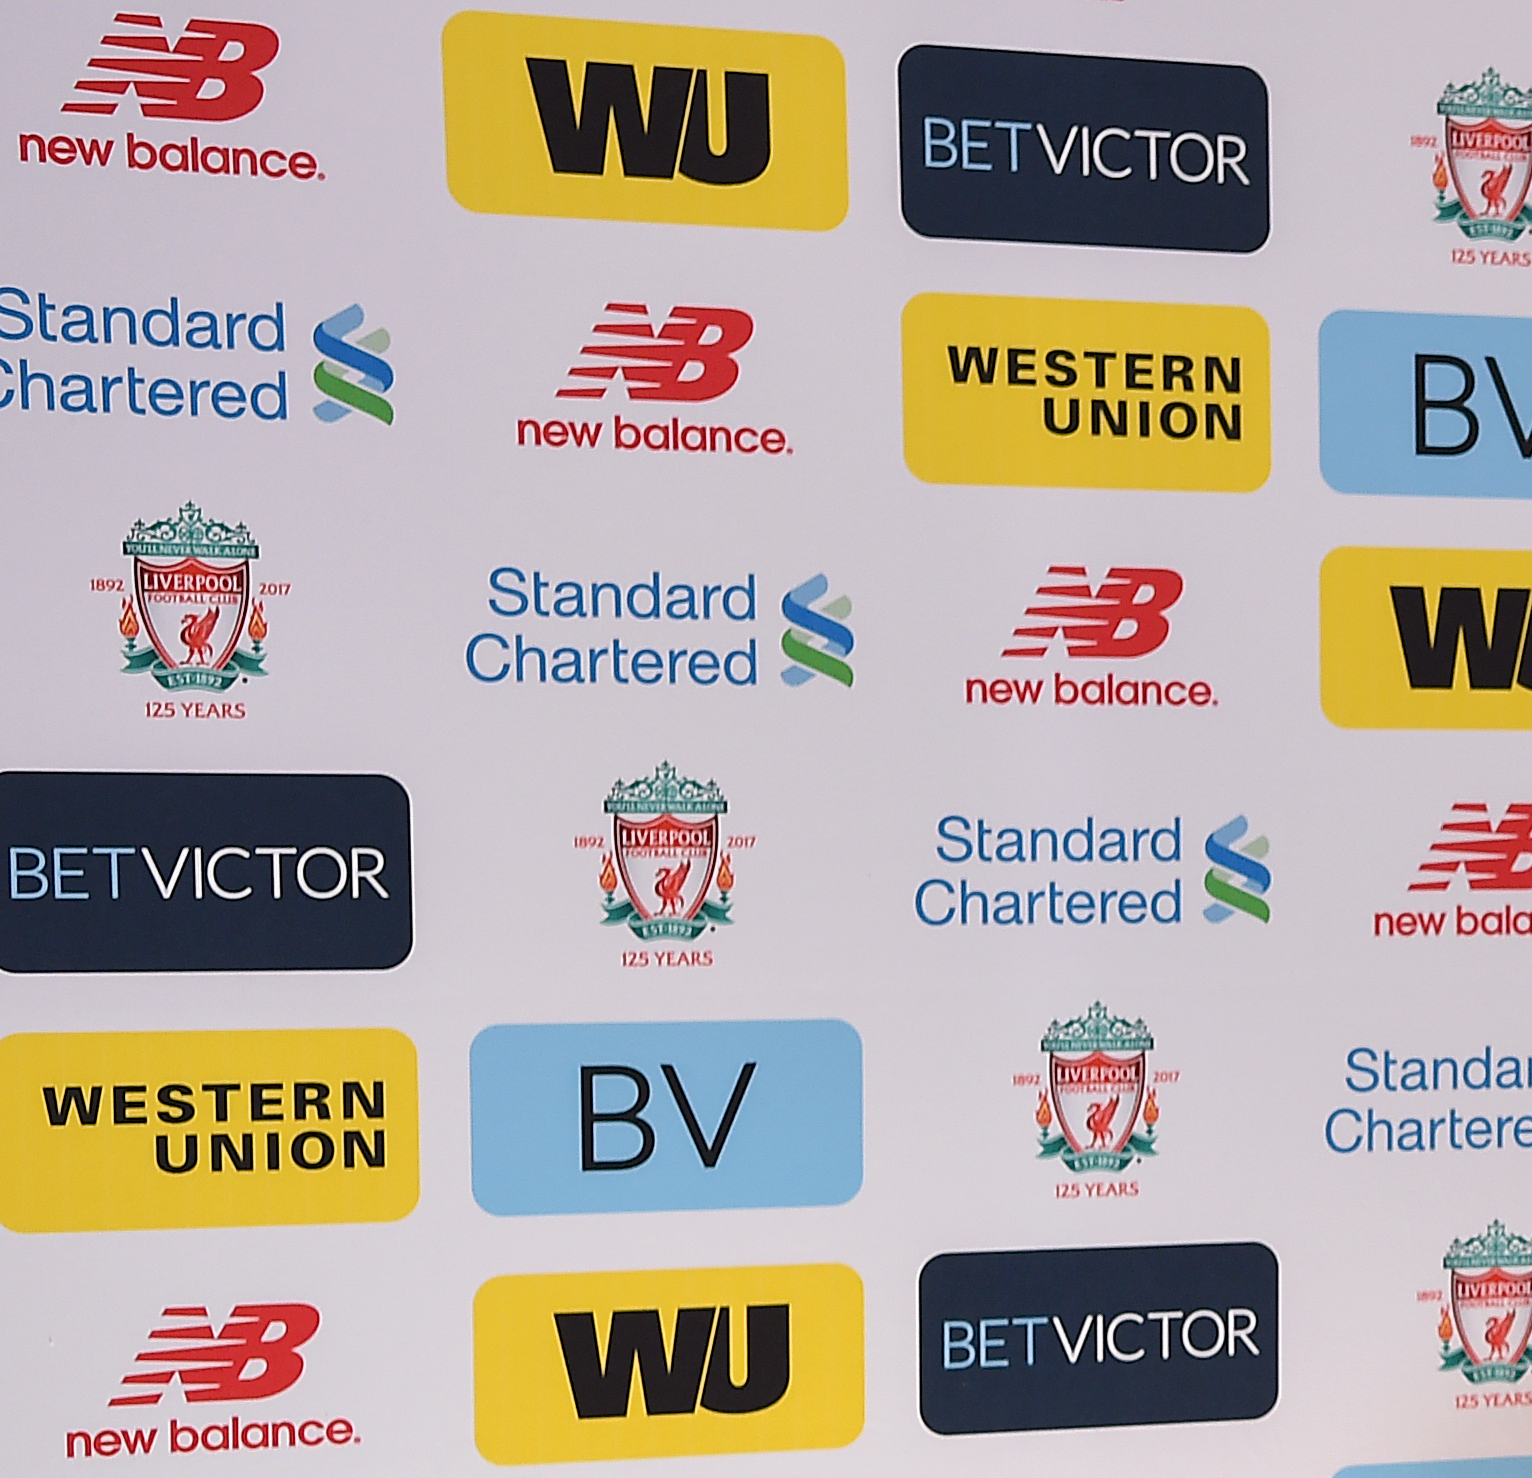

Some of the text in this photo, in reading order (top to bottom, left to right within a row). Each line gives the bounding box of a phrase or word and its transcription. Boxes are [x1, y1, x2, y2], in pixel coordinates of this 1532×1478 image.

[525, 57, 770, 185] WU
[19, 133, 115, 167] new
[925, 118, 1249, 185] BETVICTOR
[0, 287, 285, 352] Standard
[948, 346, 1240, 393] WESTERN
[517, 419, 603, 448] new
[1044, 398, 1241, 440] UNION
[90, 578, 124, 592] 1892
[143, 573, 242, 592] LIVERPOOL
[259, 582, 291, 596] 2017
[490, 567, 755, 621] Standard
[467, 633, 757, 685] Chartered
[145, 702, 246, 719] 125 YEARS
[966, 678, 1045, 705] new
[622, 829, 711, 847] LIVERPOOL
[938, 816, 1181, 862] Standard
[10, 848, 388, 899] BETVICTOR
[916, 879, 1181, 925] Chartered
[1374, 912, 1447, 937] new
[43, 1081, 384, 1126] WESTERN
[581, 1062, 756, 1171] BV
[156, 1130, 385, 1173] UNION
[944, 1309, 1259, 1368] BETVICTOR
[554, 1304, 789, 1419] WU
[66, 1428, 158, 1458] new
